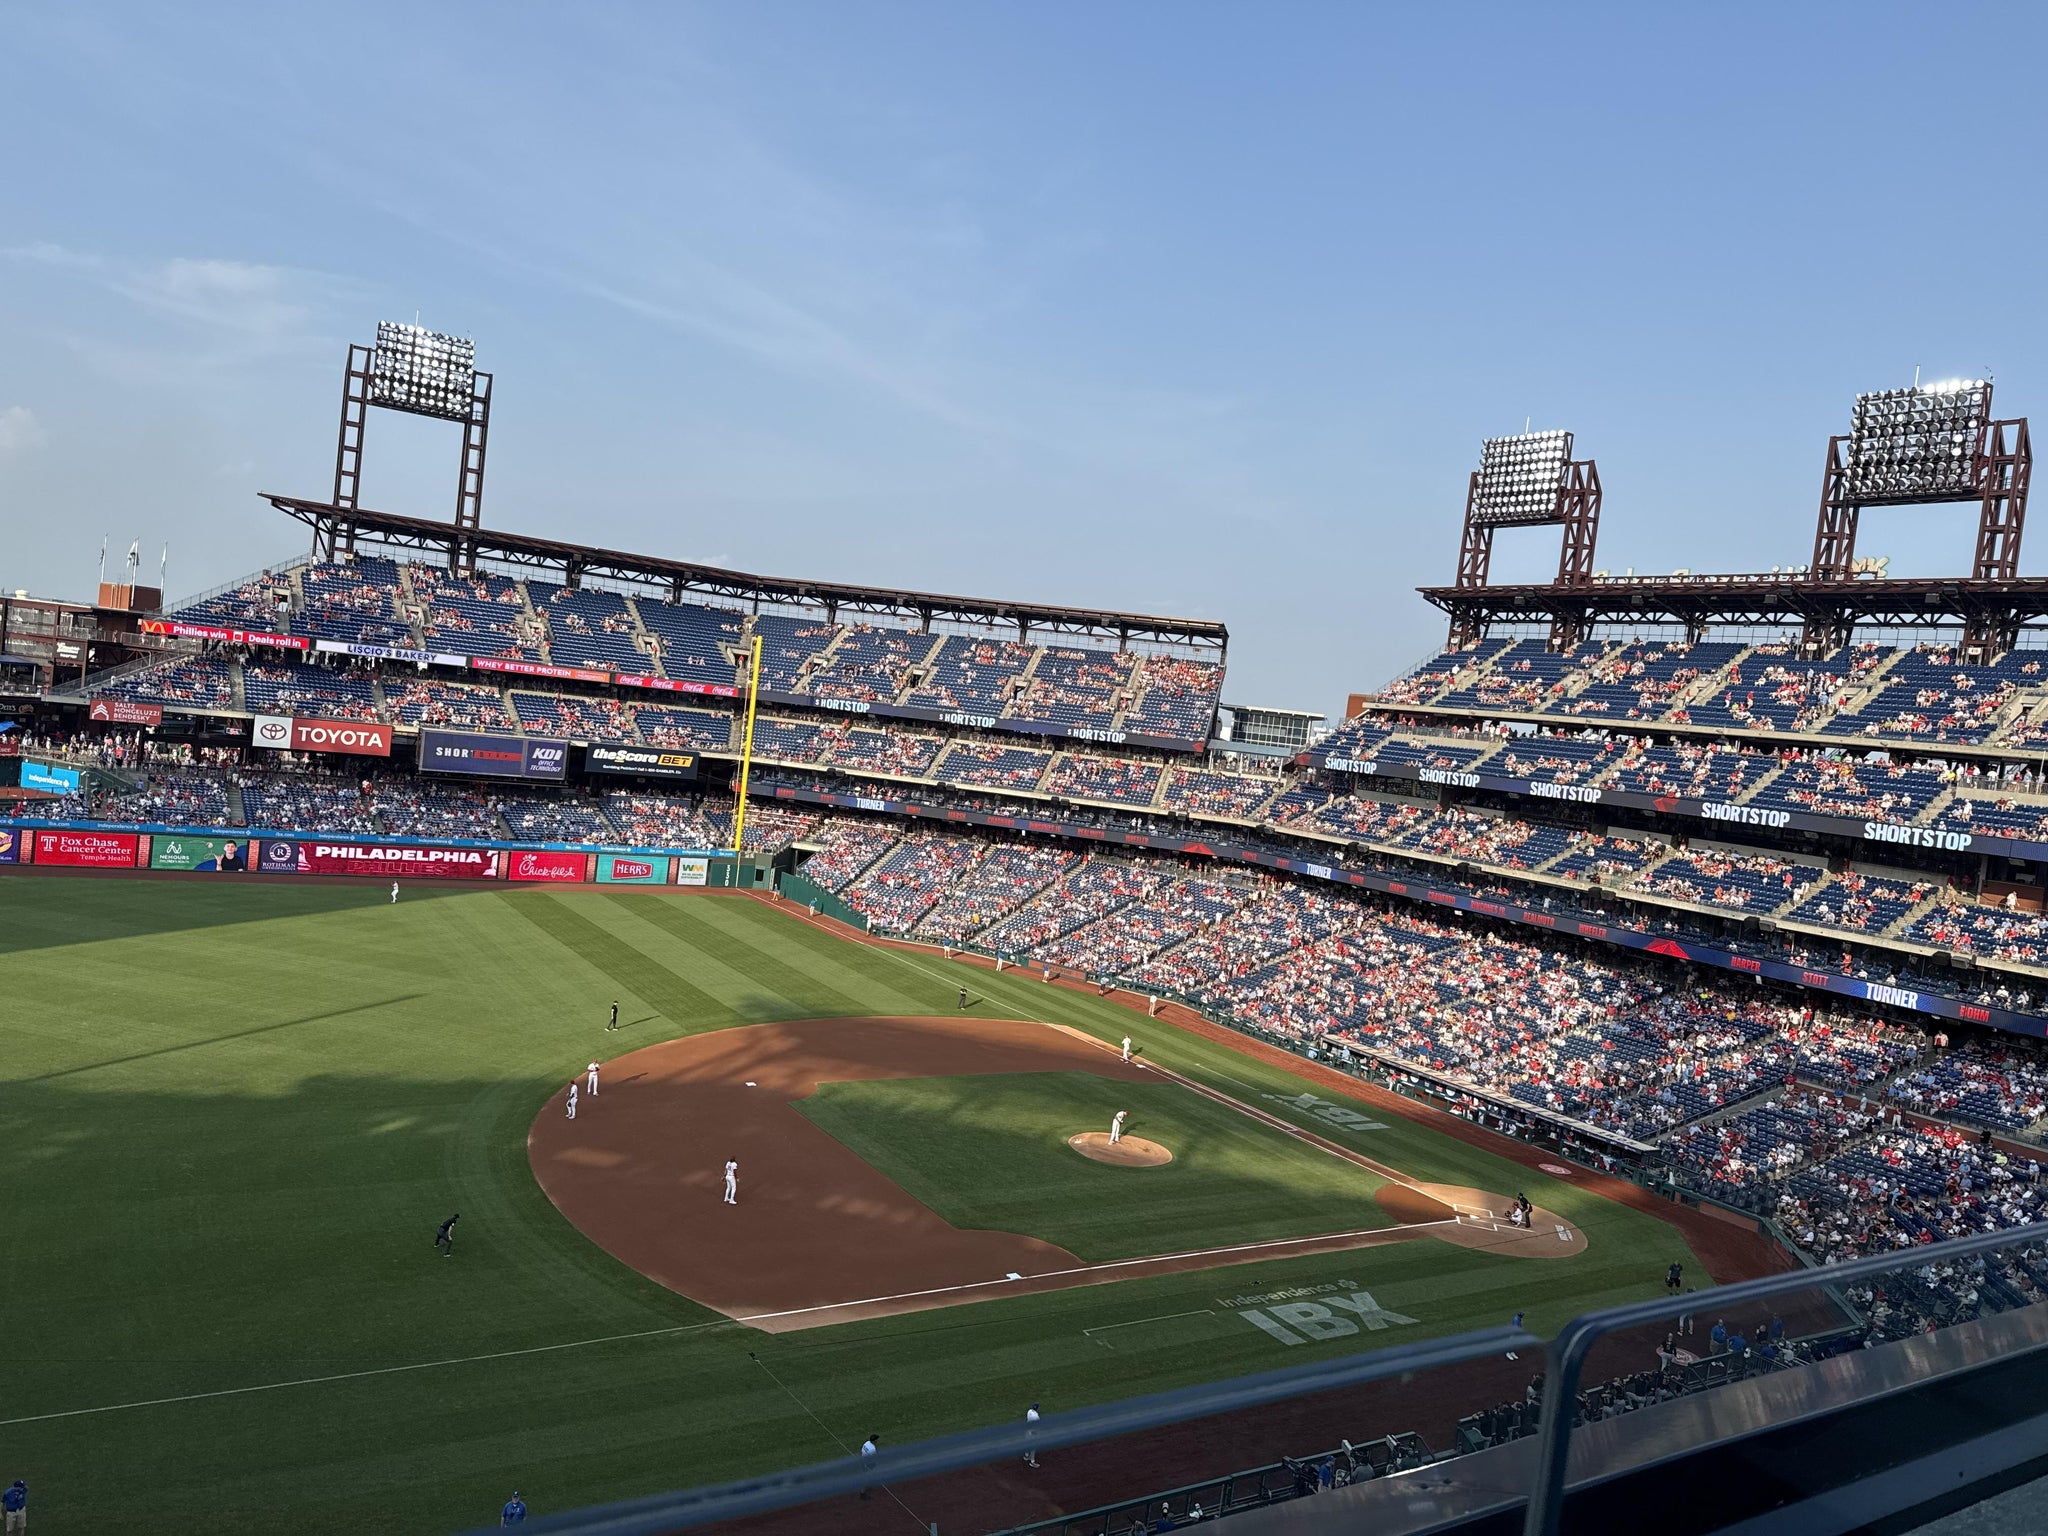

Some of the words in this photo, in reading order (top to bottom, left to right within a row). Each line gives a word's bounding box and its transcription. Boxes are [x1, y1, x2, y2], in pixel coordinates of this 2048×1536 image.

[173, 626, 208, 638] Phillies
[210, 631, 227, 639] win
[249, 635, 274, 645] Deals
[275, 637, 291, 646] roll
[293, 639, 301, 647] in
[347, 645, 392, 657] LISCIO'S
[396, 649, 437, 662] BAKERY
[477, 659, 502, 670] WHEY
[504, 662, 534, 673] BETTER
[536, 666, 572, 677] PROTEIN
[113, 707, 160, 716] MONGELUZZI
[113, 713, 151, 721] BENDESKY
[297, 727, 383, 748] TOYOTA
[592, 748, 658, 763] theScore
[661, 755, 690, 765] BET
[529, 765, 562, 773] TECHNOLOGY
[1324, 757, 1377, 775] SHORTSTOP
[1419, 768, 1480, 788] SHORTSTOP
[1530, 781, 1602, 803] SHORTSTOP
[856, 797, 885, 811] TURNER
[1701, 802, 1790, 828] SHORTSTOP
[61, 837, 82, 846] Fox
[84, 838, 119, 847] Chase
[1863, 822, 1972, 852] SHORTSTOP
[60, 845, 95, 853] Cancer
[98, 846, 132, 855] Center
[315, 846, 482, 863] PHILADELPHIA
[616, 863, 648, 875] HERR'S
[1306, 863, 1332, 880] TURNER
[1730, 956, 1761, 972] HARPER
[1802, 971, 1829, 986] STOTT
[1866, 982, 1919, 1009] TURNER
[1215, 1281, 1337, 1309] Independence
[1238, 1291, 1421, 1346] IBX
